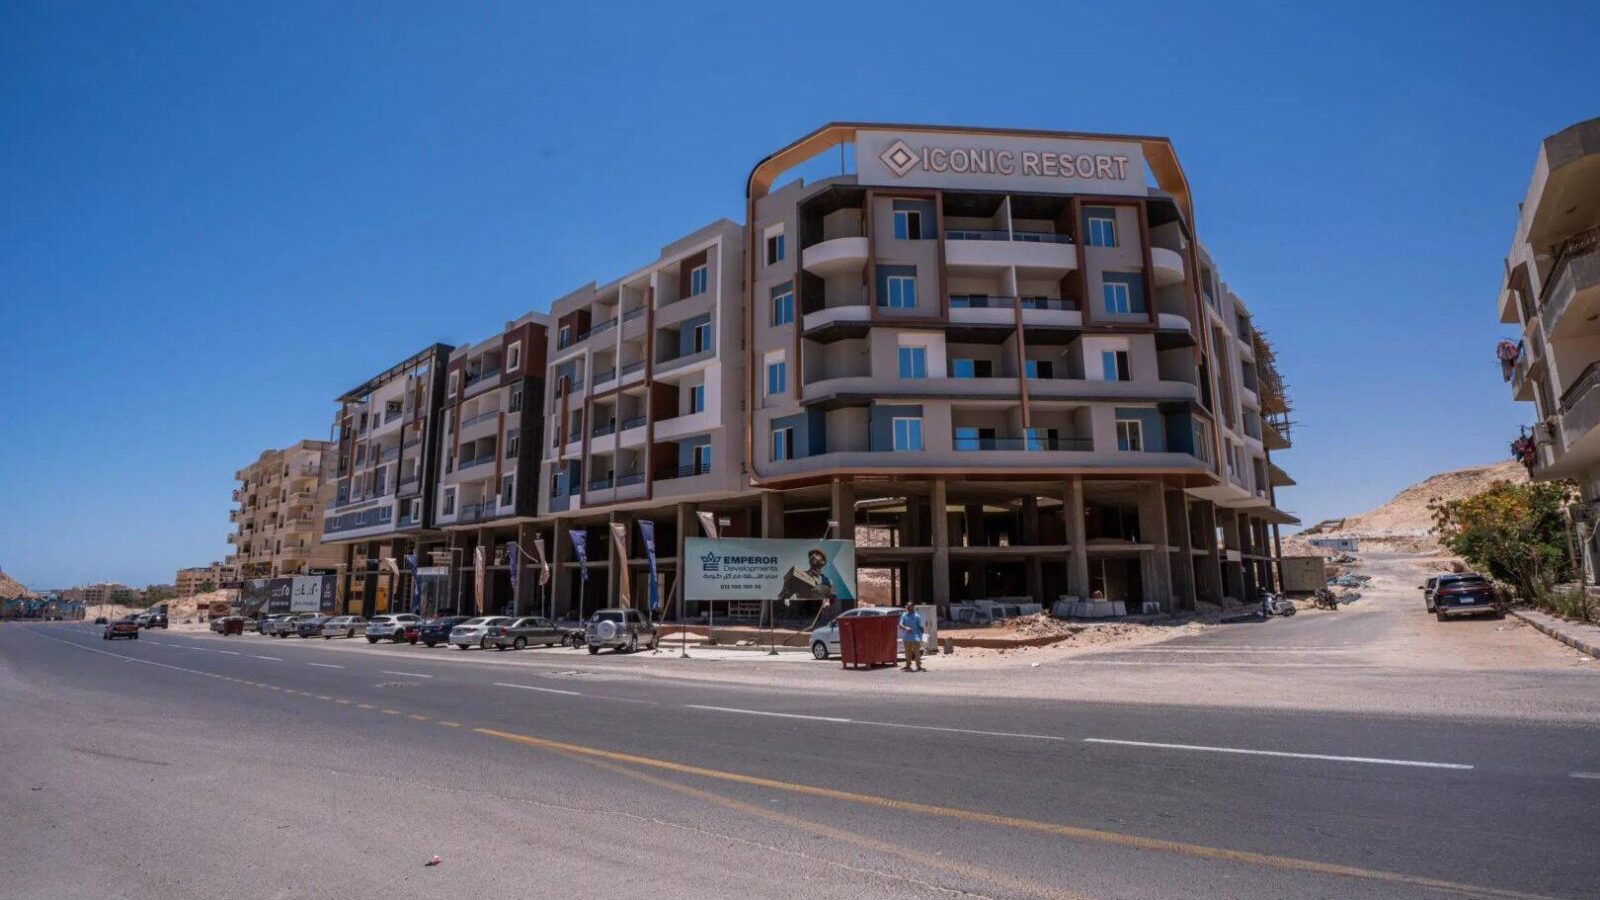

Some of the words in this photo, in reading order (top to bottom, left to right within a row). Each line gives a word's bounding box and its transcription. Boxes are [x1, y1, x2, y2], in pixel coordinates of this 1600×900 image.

[921, 147, 1015, 175] ICONIC
[1021, 151, 1129, 180] RESORT
[723, 556, 778, 565] EMPEROR
[723, 564, 778, 572] Developments
